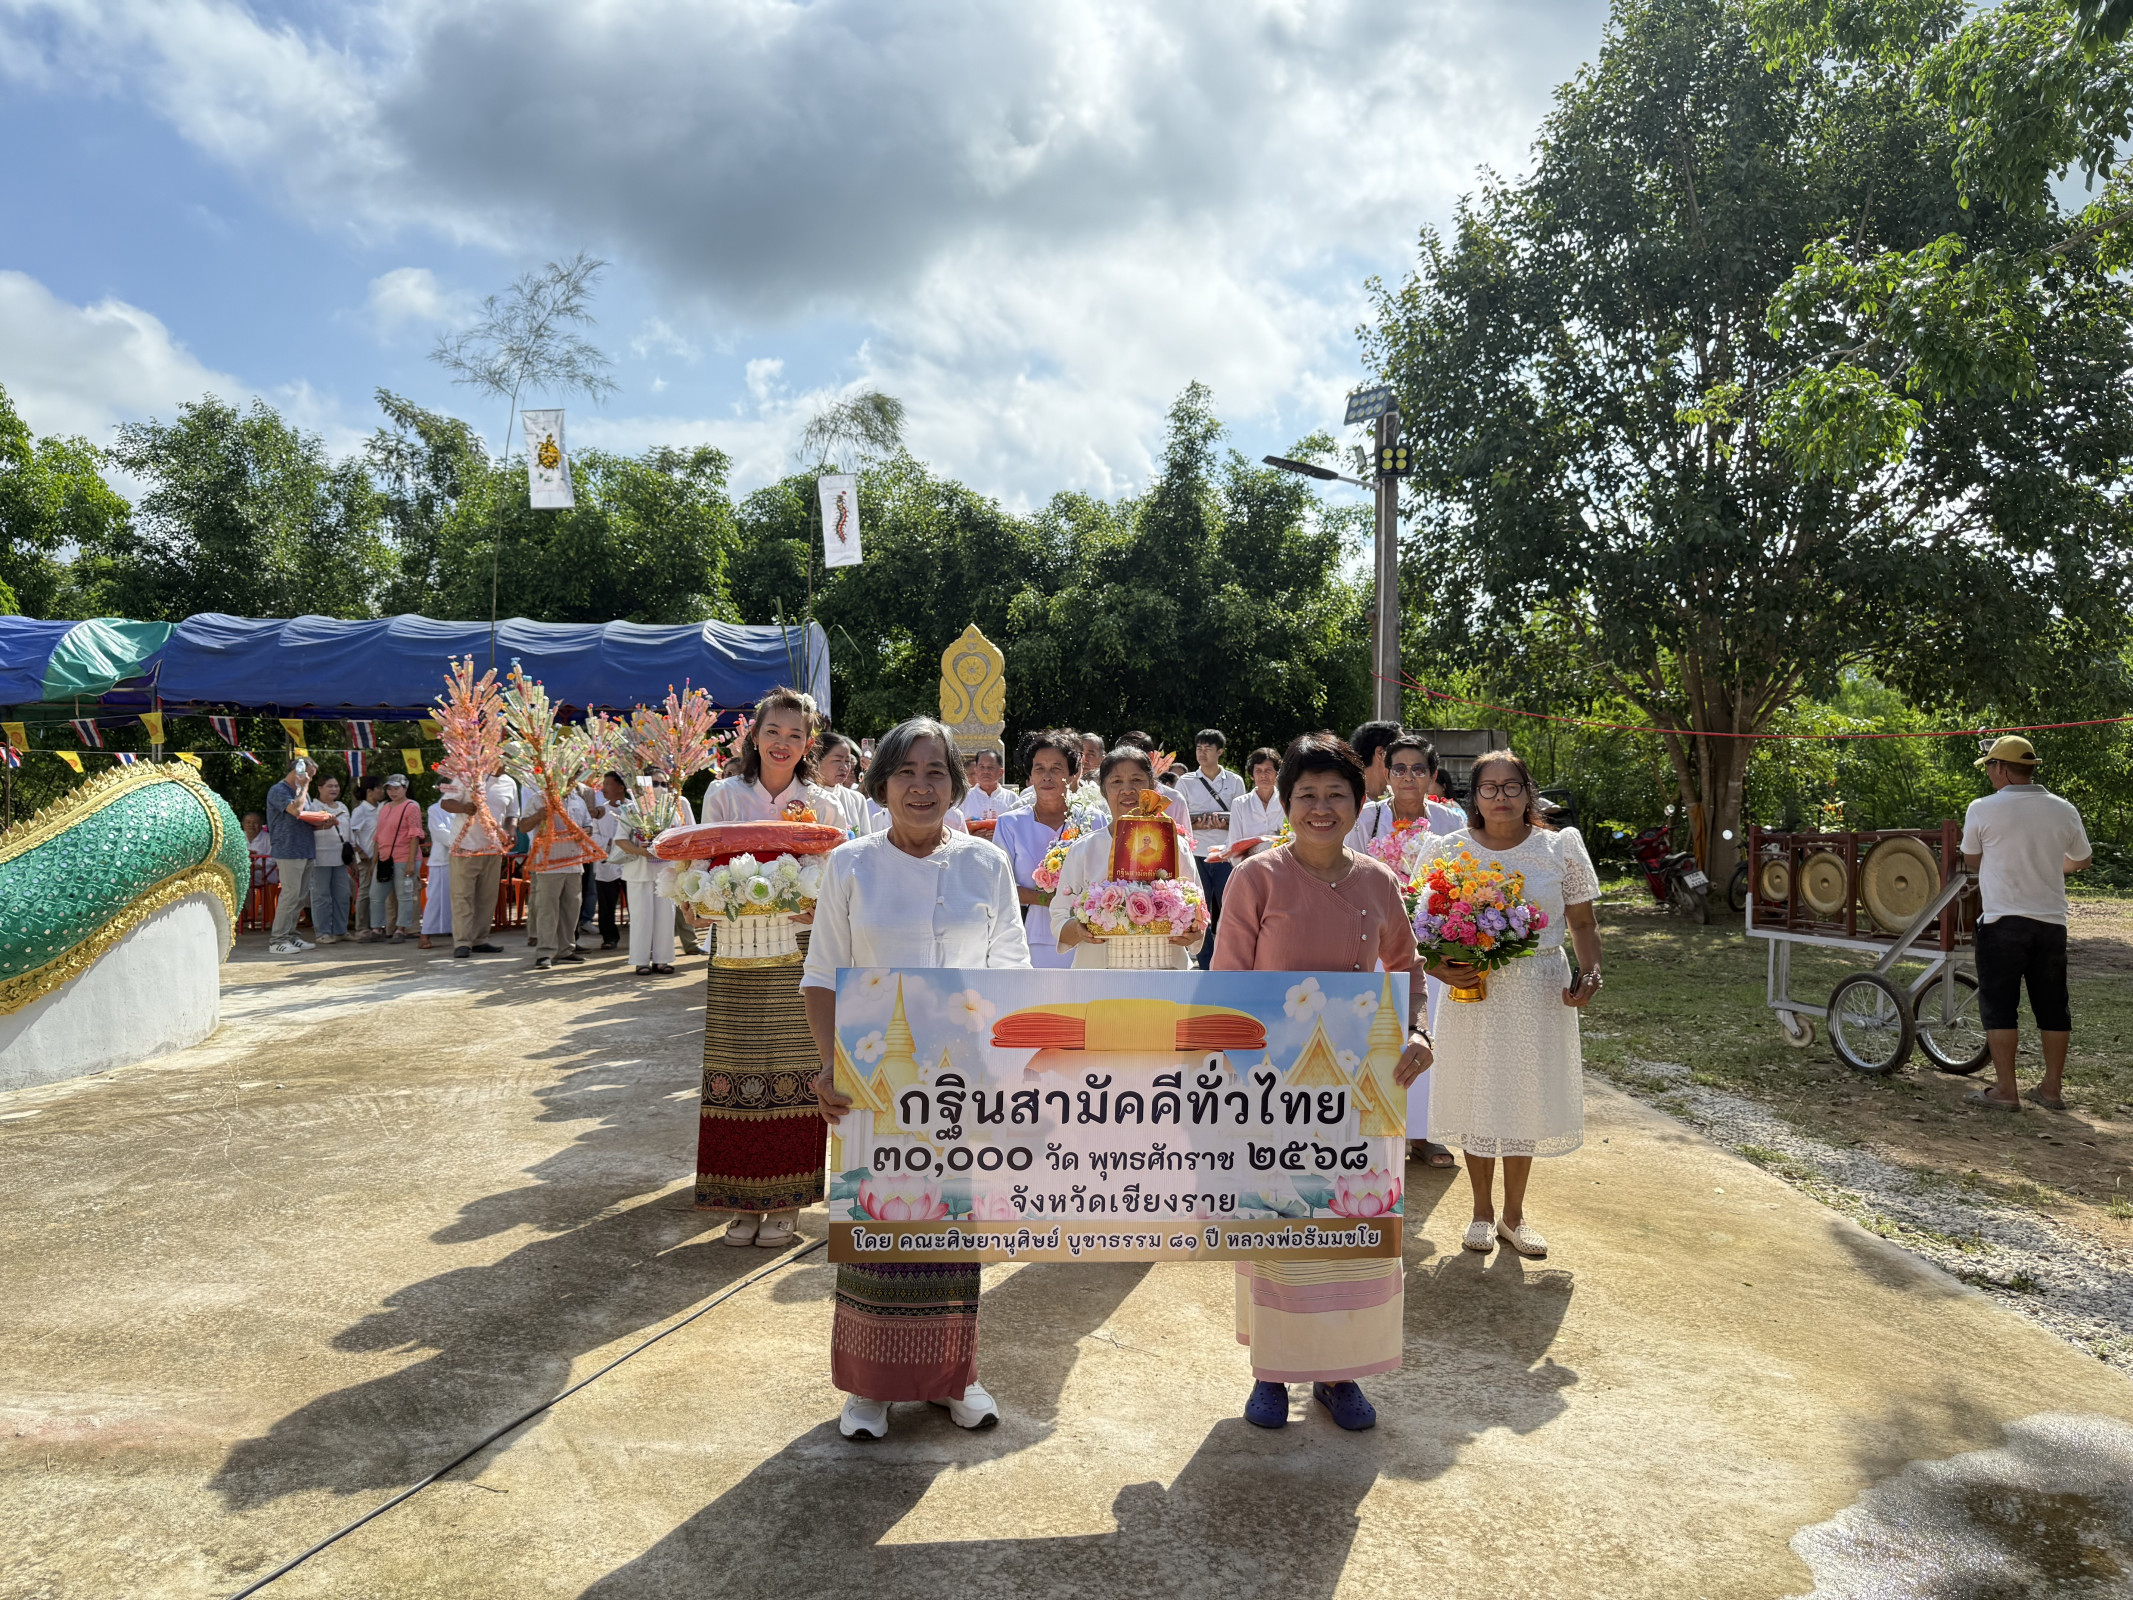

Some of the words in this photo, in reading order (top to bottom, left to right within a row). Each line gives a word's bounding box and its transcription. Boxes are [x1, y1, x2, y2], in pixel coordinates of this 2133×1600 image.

[900, 1059, 1345, 1140] กฐินสามัคคีทั่วไทย
[873, 1147, 1033, 1178] ๓๐,๐๐๐
[1046, 1143, 1079, 1171] วัด
[1089, 1143, 1234, 1181] พุทธศักราช
[1247, 1141, 1368, 1171] ๒๕๖๘
[1011, 1183, 1236, 1213] จังหวัดเชียงราย
[852, 1229, 891, 1249] โดย
[901, 1228, 1059, 1255] คณะศิษยานุศิษย์
[1067, 1234, 1161, 1255] บูชาธรรม
[1169, 1235, 1197, 1249] ๘๑
[1205, 1228, 1219, 1247] ปี
[1227, 1225, 1380, 1247] หลวงพ่อธัมมชโย
